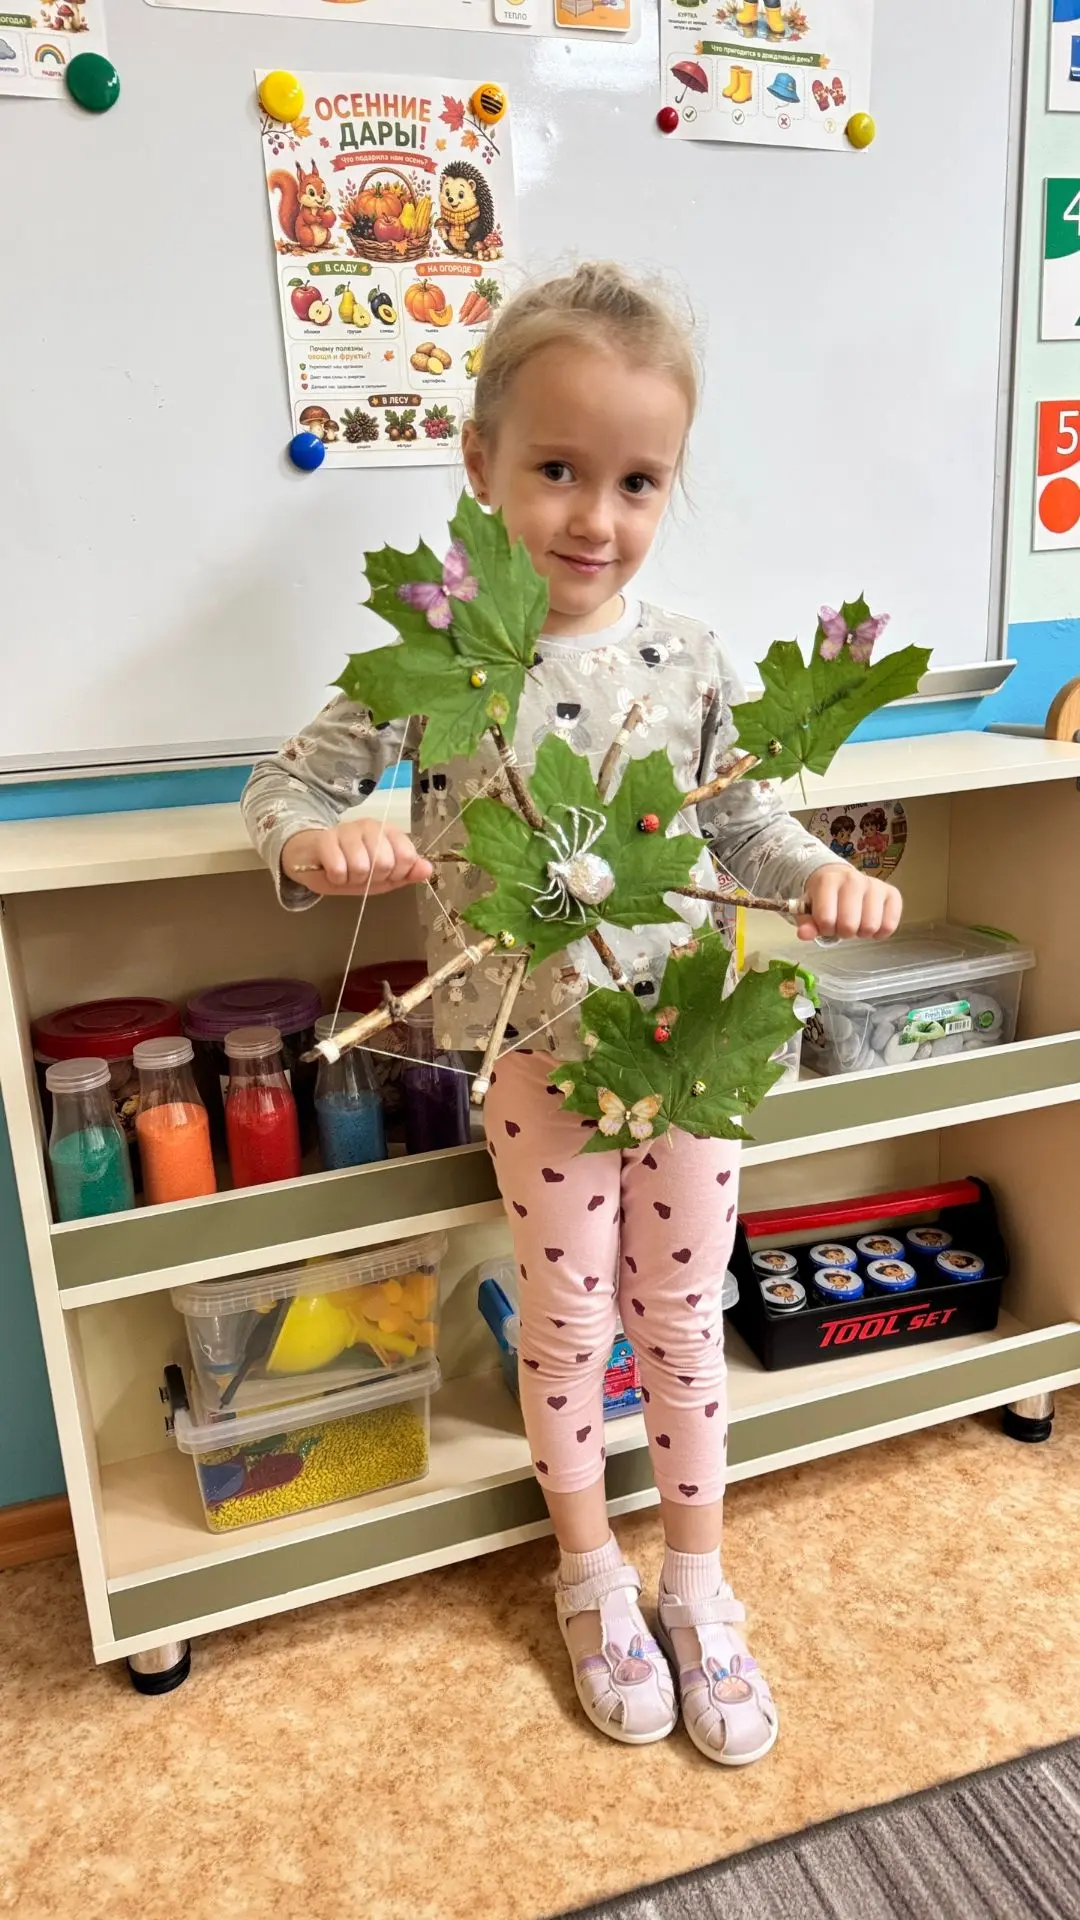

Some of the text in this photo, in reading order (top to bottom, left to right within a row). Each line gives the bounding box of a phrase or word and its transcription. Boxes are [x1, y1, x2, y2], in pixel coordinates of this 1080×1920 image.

[0, 16, 26, 24] ОГОДА?
[504, 12, 527, 20] ТЕПЛО
[711, 44, 722, 52] Что
[724, 46, 756, 57] пригодится
[762, 52, 795, 61] дождливый
[315, 93, 432, 122] ОСЕННИЕ
[339, 121, 427, 151] ДАРЫ!
[355, 154, 389, 162] подарила
[404, 157, 428, 166] осень?
[1063, 188, 1080, 236] 4
[333, 263, 358, 273] САДУ
[439, 264, 472, 273] ОГОРОДЕ
[339, 352, 371, 361] фрукты?
[1056, 410, 1080, 455] 5
[818, 1305, 957, 1348] TOOL SET
